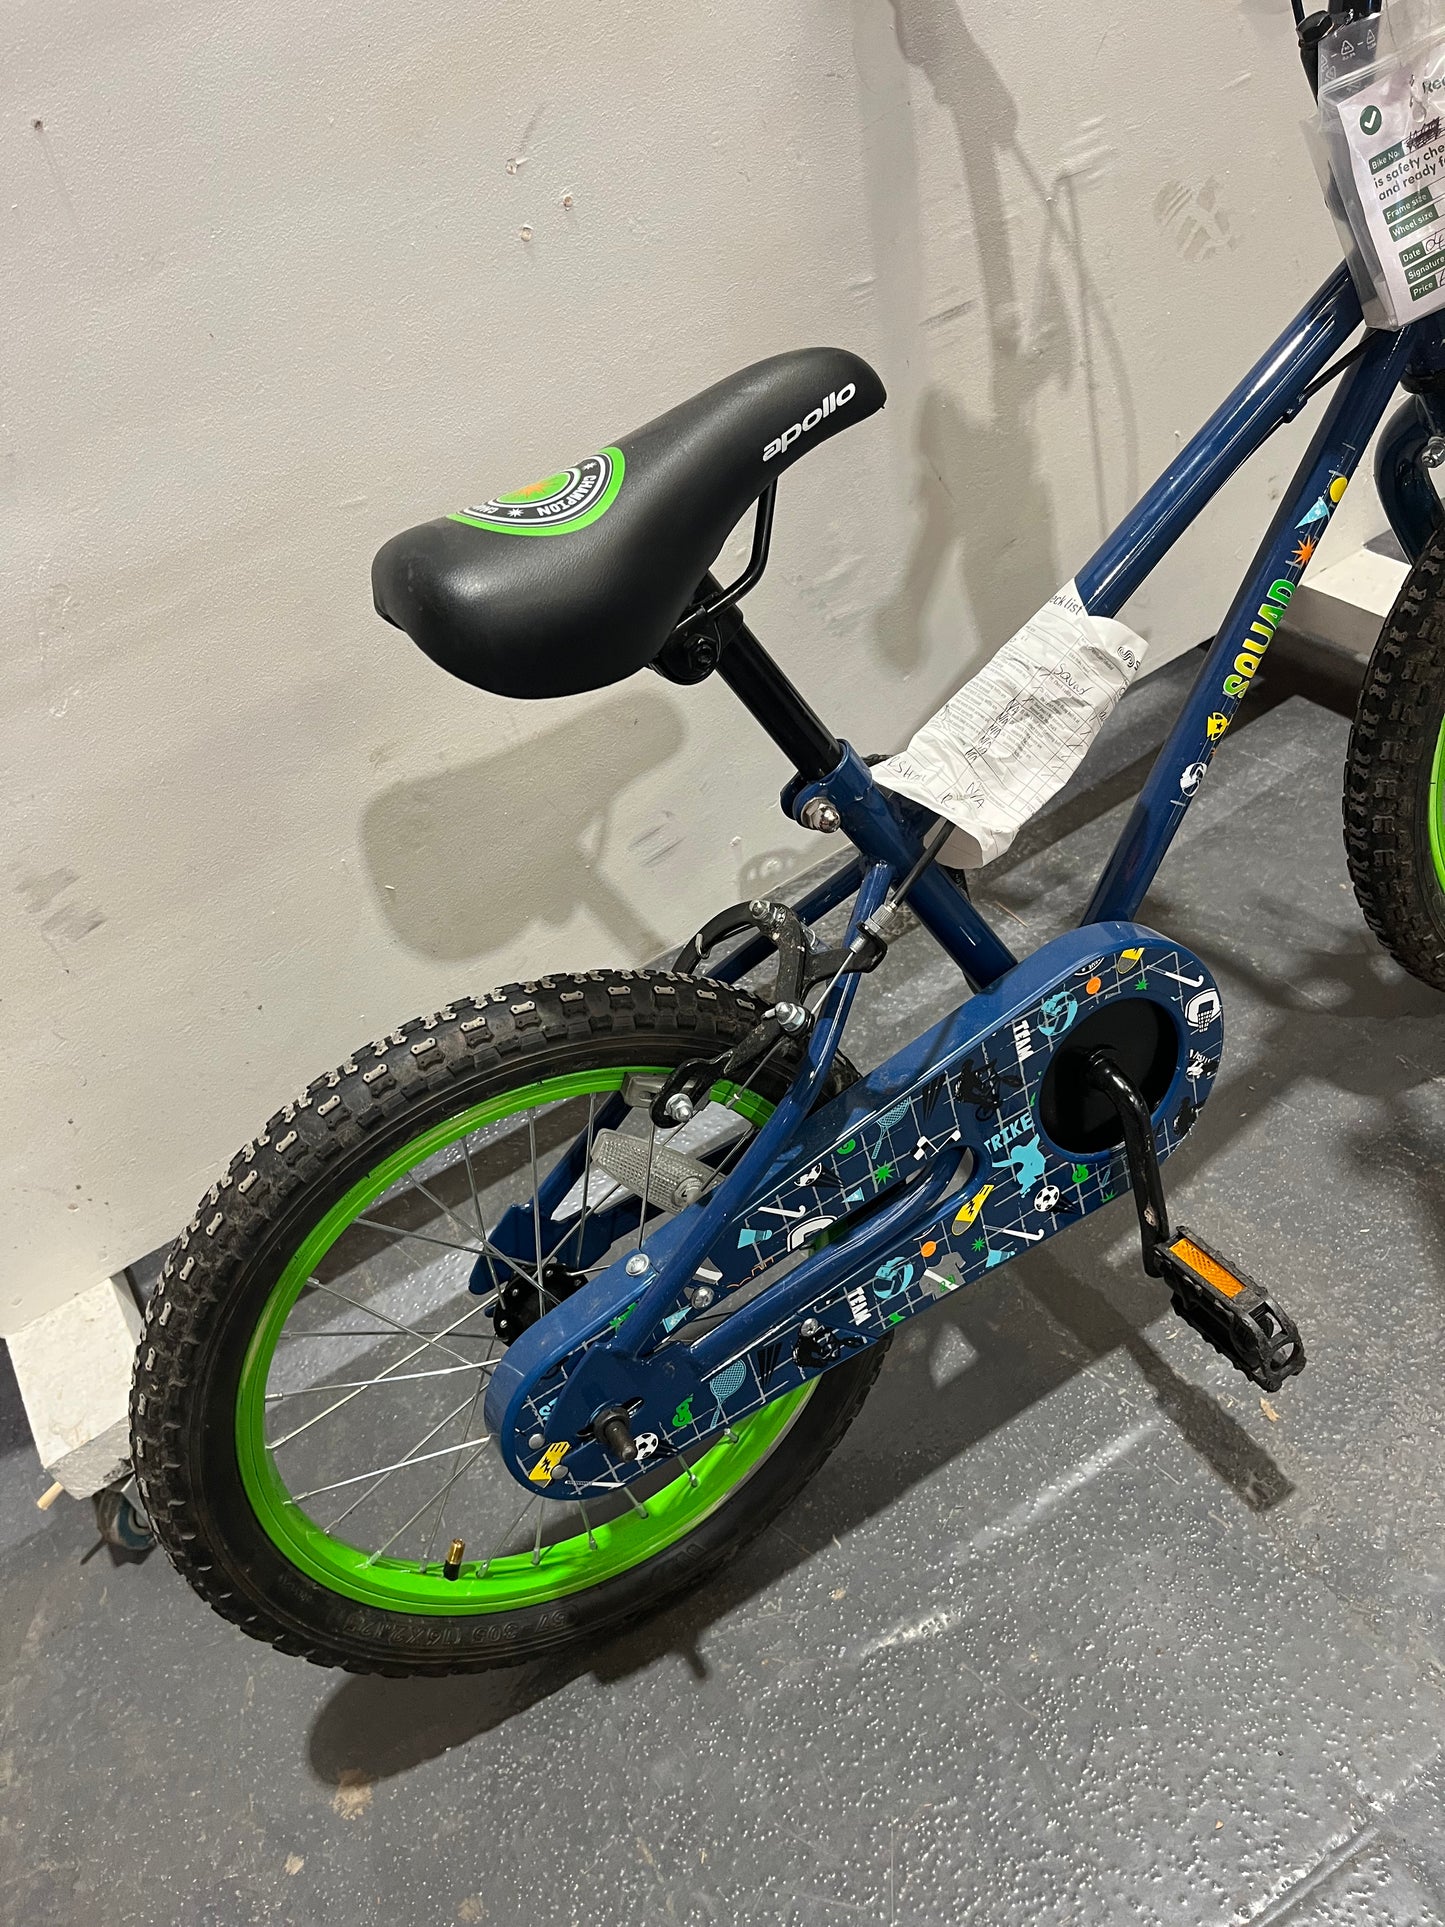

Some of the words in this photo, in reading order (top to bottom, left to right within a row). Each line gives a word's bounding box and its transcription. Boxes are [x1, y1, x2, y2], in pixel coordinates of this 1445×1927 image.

[1371, 157, 1387, 170] Bike
[1374, 177, 1384, 188] is
[1386, 156, 1420, 181] safety
[1379, 180, 1400, 200] and
[1403, 163, 1436, 187] ready
[1386, 202, 1411, 220] Frame
[1411, 194, 1427, 206] size
[1392, 218, 1417, 237] Wheel
[1418, 211, 1434, 223] size
[1402, 249, 1421, 262] Date
[1408, 256, 1445, 280] Signature
[1413, 282, 1434, 297] Price
[763, 383, 856, 462] apollo
[536, 474, 598, 517] CHAMPION
[1223, 578, 1297, 698] SQUAD
[1013, 1019, 1035, 1063] TEAM
[847, 1286, 872, 1326] TEAM
